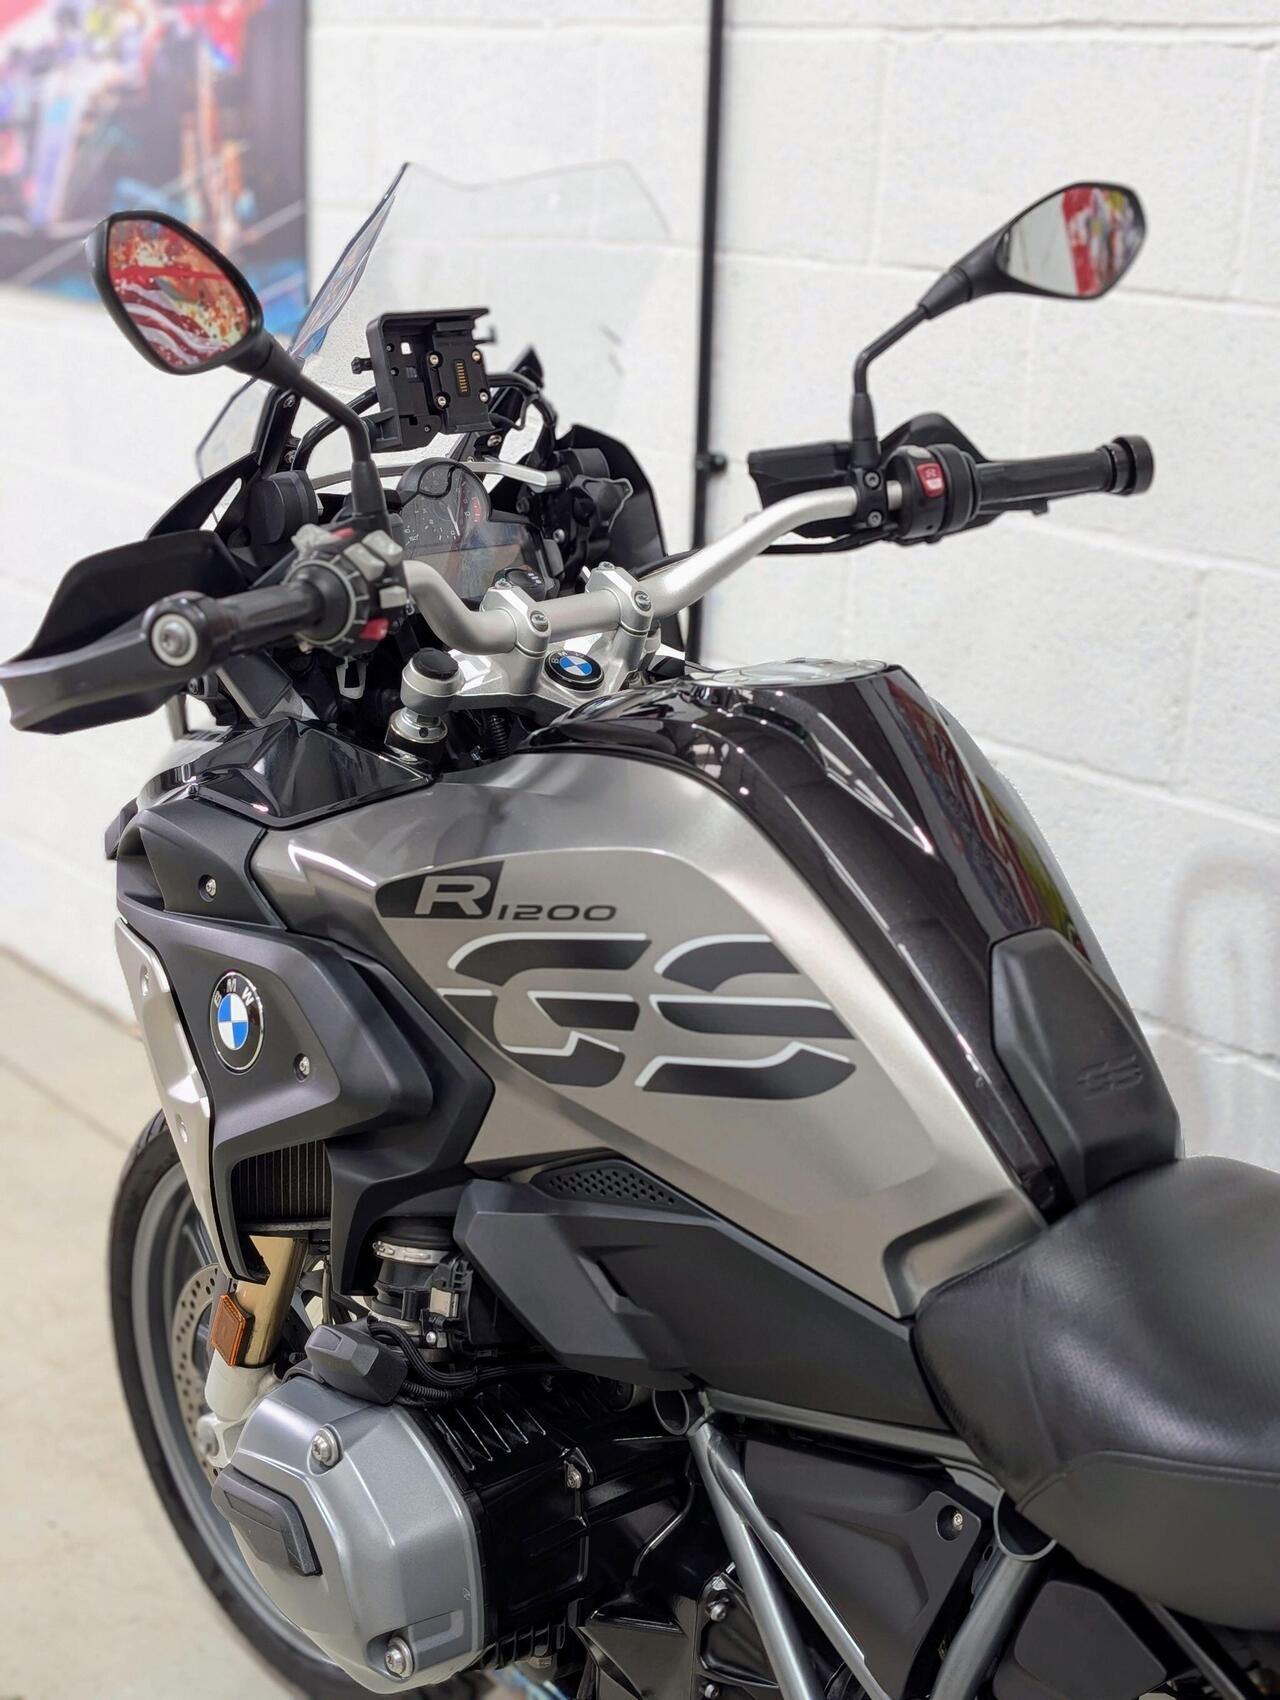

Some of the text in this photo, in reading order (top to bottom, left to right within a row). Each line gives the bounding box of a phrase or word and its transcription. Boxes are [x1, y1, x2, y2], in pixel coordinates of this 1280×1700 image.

[415, 875, 617, 921] R 1200
[214, 978, 254, 1007] BMW
[437, 932, 858, 1100] GS
